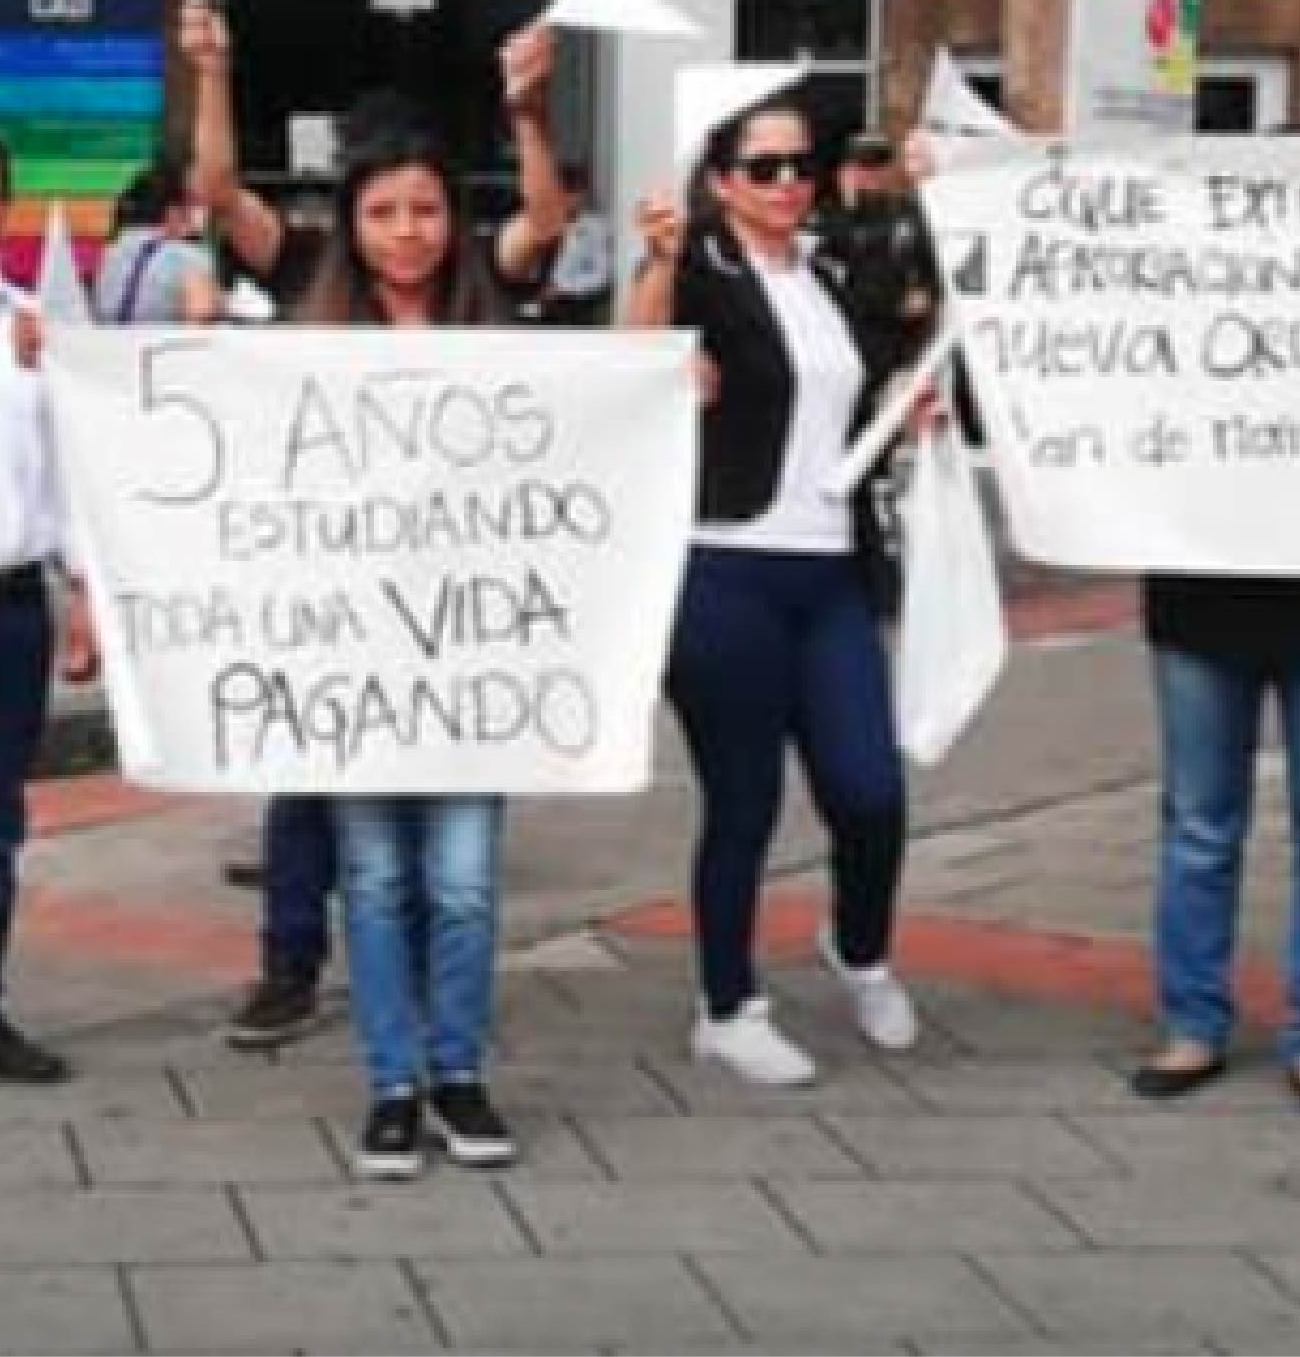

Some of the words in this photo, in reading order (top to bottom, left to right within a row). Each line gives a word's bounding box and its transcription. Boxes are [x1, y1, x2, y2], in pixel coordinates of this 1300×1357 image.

[131, 340, 225, 504] 5
[282, 370, 553, 490] AÑOS
[218, 480, 611, 561] ESTUDIANDO
[115, 584, 242, 654] TODA
[262, 590, 367, 650] UNA
[381, 568, 568, 659] VIDA
[211, 662, 599, 771] PAGANDO
